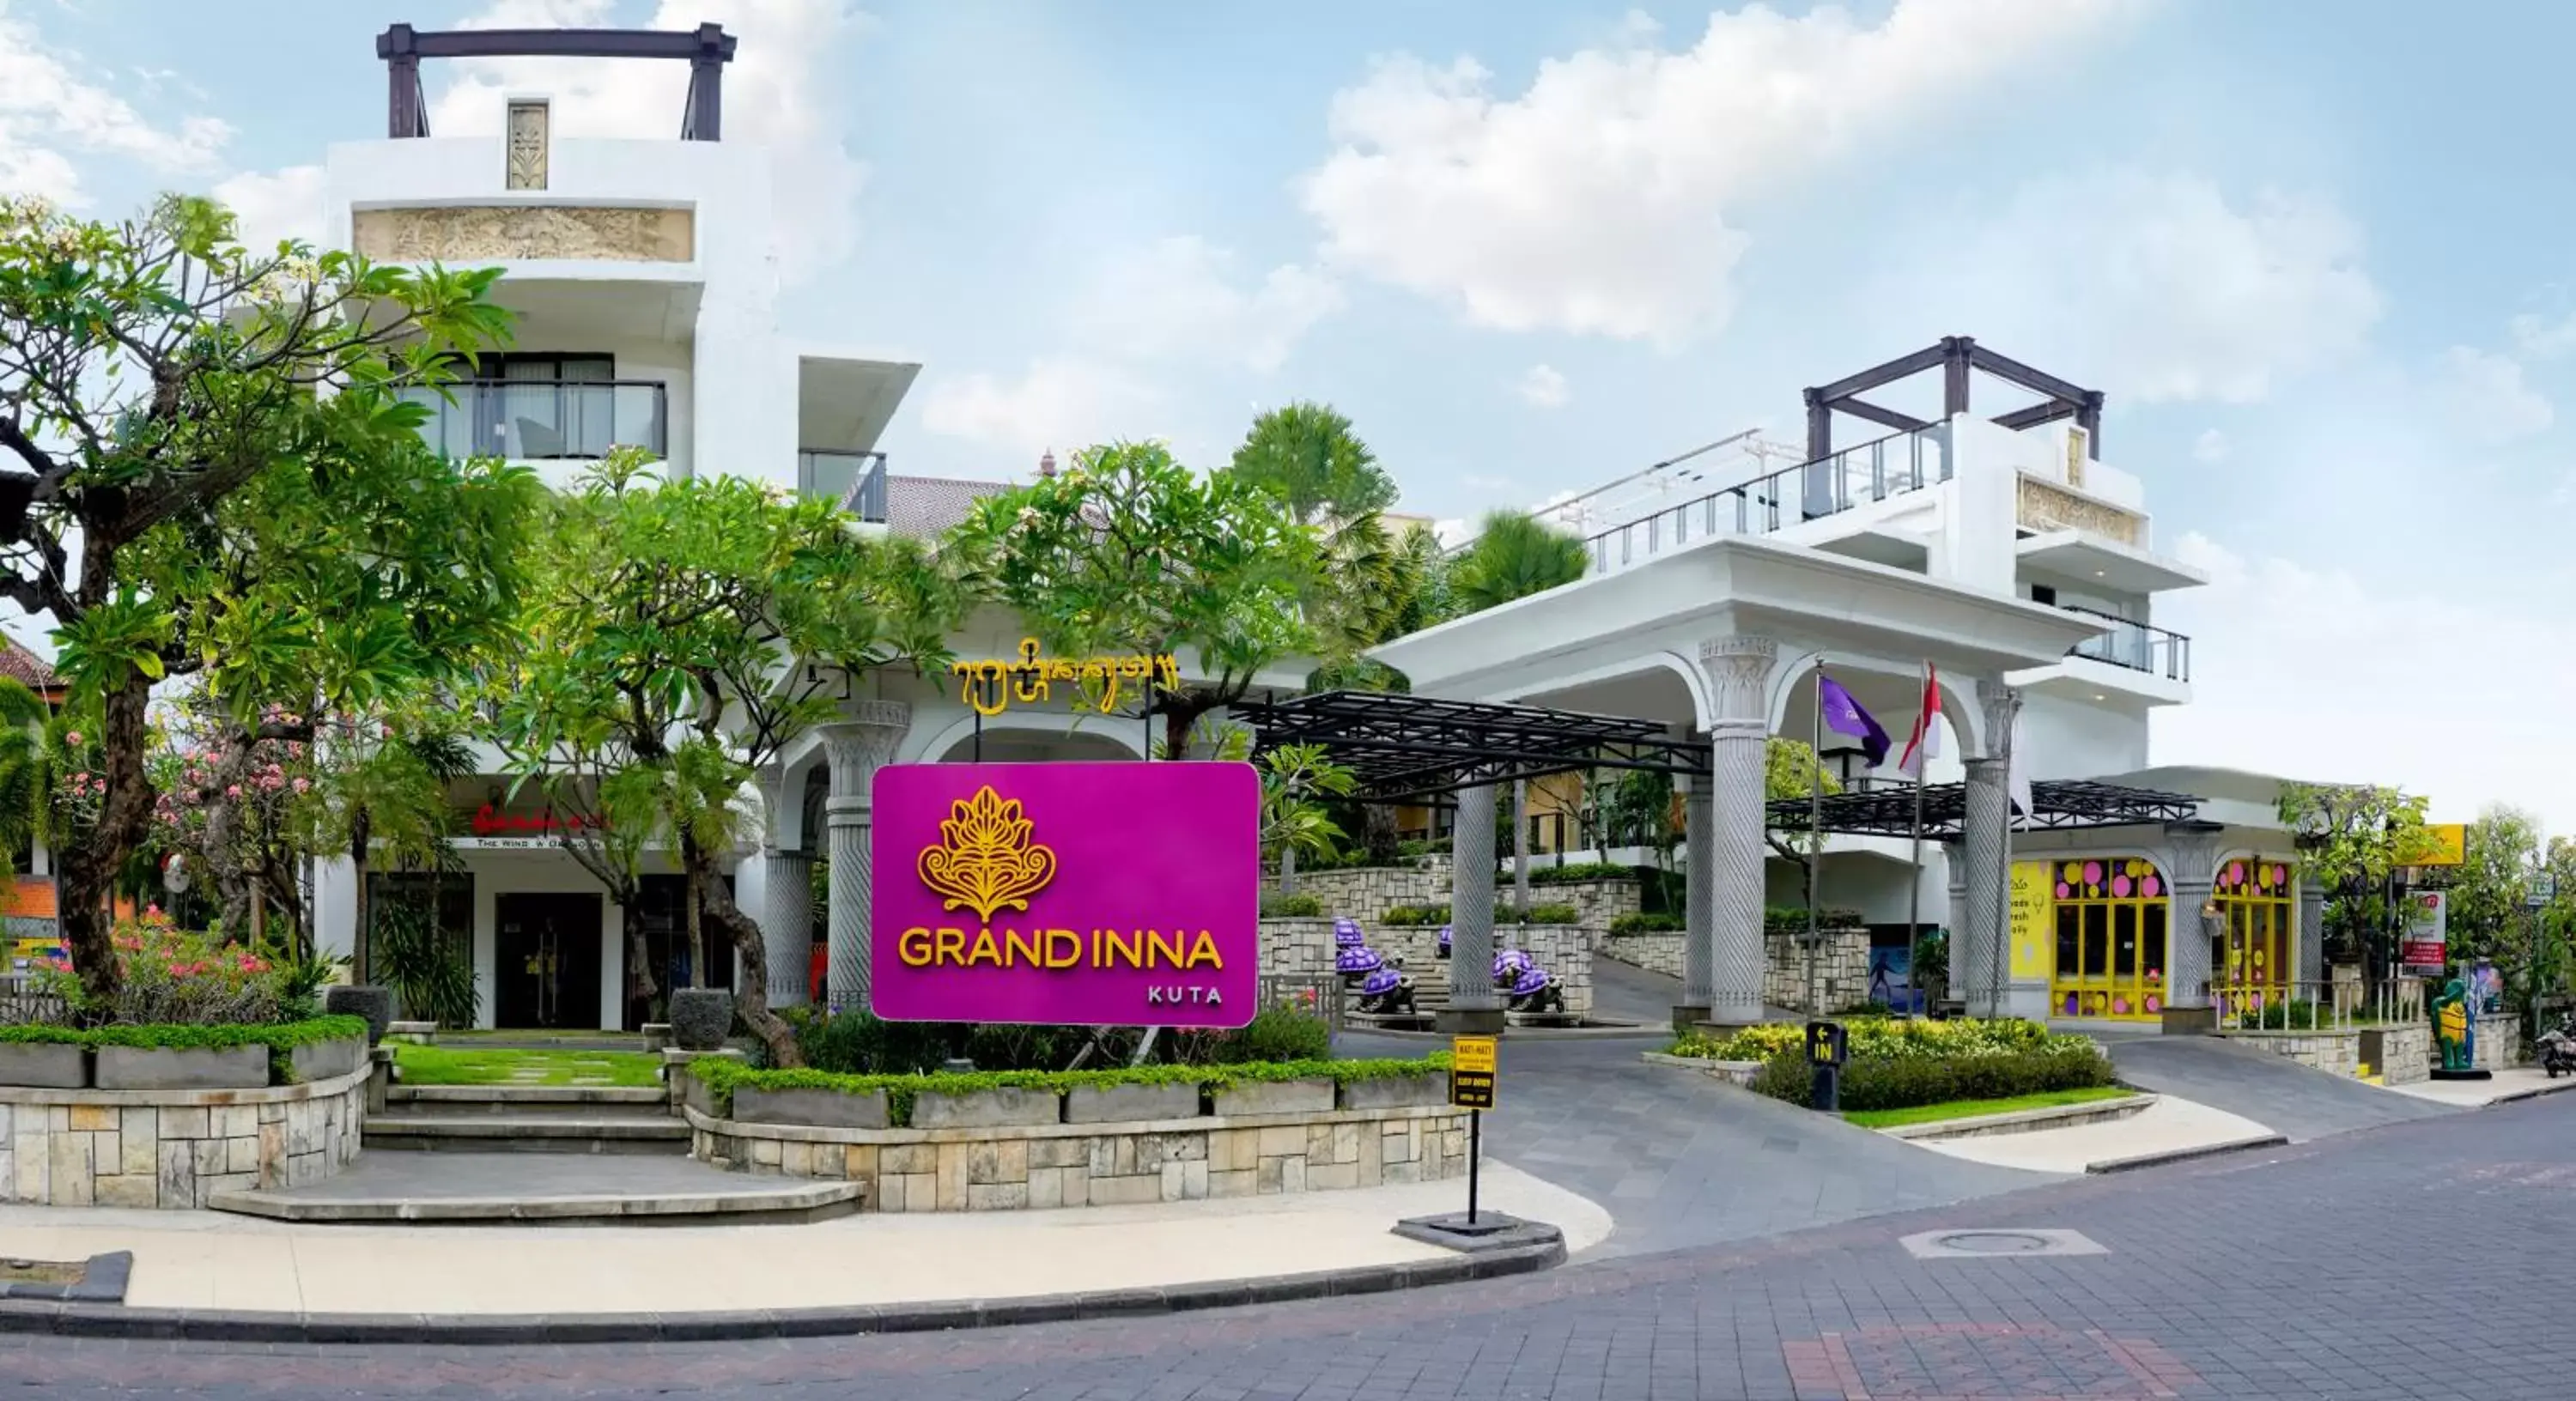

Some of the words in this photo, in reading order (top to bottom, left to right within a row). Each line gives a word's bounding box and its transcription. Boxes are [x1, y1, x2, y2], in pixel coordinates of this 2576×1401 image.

[898, 928, 1082, 968] GRAND
[1092, 929, 1223, 969] INNA
[1147, 986, 1222, 1004] KUTA
[1814, 1043, 1832, 1060] IN
